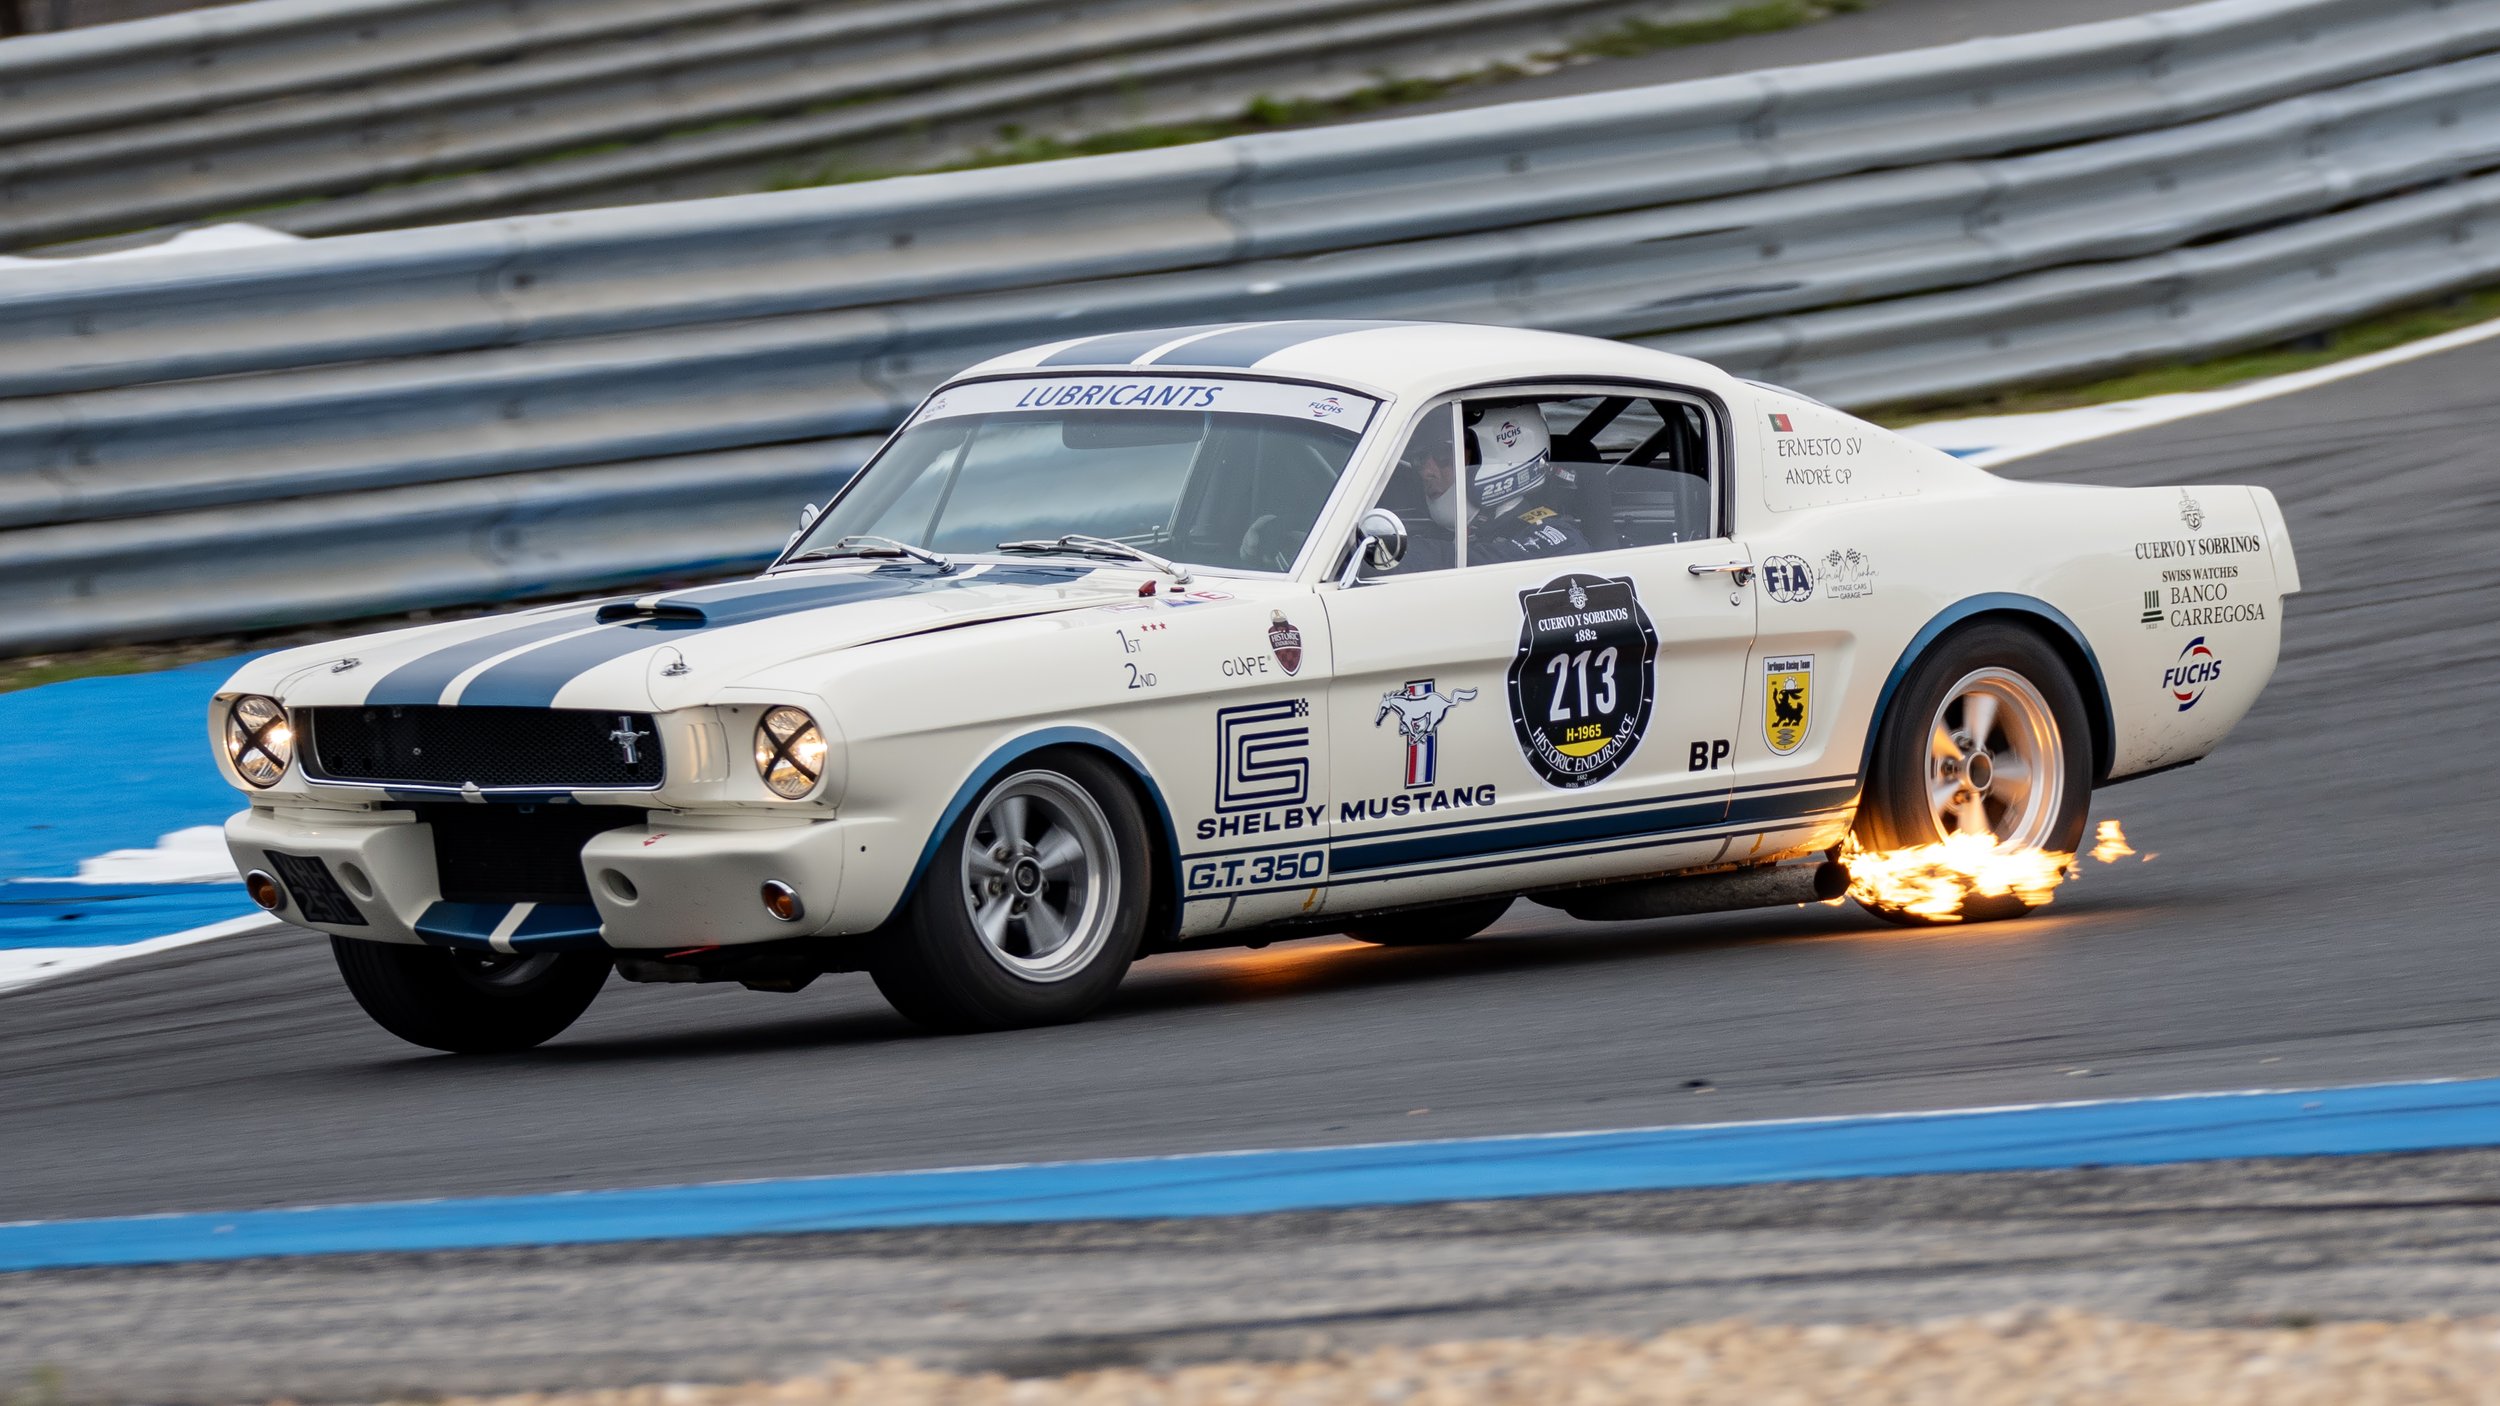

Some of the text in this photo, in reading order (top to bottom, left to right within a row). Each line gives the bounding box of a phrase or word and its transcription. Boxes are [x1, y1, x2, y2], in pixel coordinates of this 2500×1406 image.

[1015, 384, 1225, 409] LUBRICANTS
[1308, 400, 1345, 415] FUCHS
[1496, 425, 1521, 443] FUCHS
[1777, 437, 1863, 458] ERNESTO SV
[1785, 465, 1853, 485] ANDRÉ CP
[1481, 476, 1514, 497] 213
[2135, 535, 2261, 560] CUERVO Y SOBRINOS
[2162, 565, 2239, 582] SWISS WATCHES
[1839, 592, 1862, 600] GARAGE
[2170, 583, 2228, 605] BANCO
[1538, 607, 1629, 632] CUERVO Y SOBRINOS
[2170, 603, 2266, 627] CARREGOSA
[1271, 631, 1300, 643] HISTORIC
[1575, 629, 1598, 643] 1882
[1800, 660, 1811, 670] Team
[2162, 660, 2222, 689] FUCHS
[1546, 646, 1618, 722] 213
[1532, 713, 1636, 772] HISTORIC ENDURANCE
[1566, 724, 1602, 742] H-1965
[1688, 738, 1731, 773] BP
[1340, 784, 1496, 824] MUSTANG
[1196, 804, 1326, 840] SHELBY
